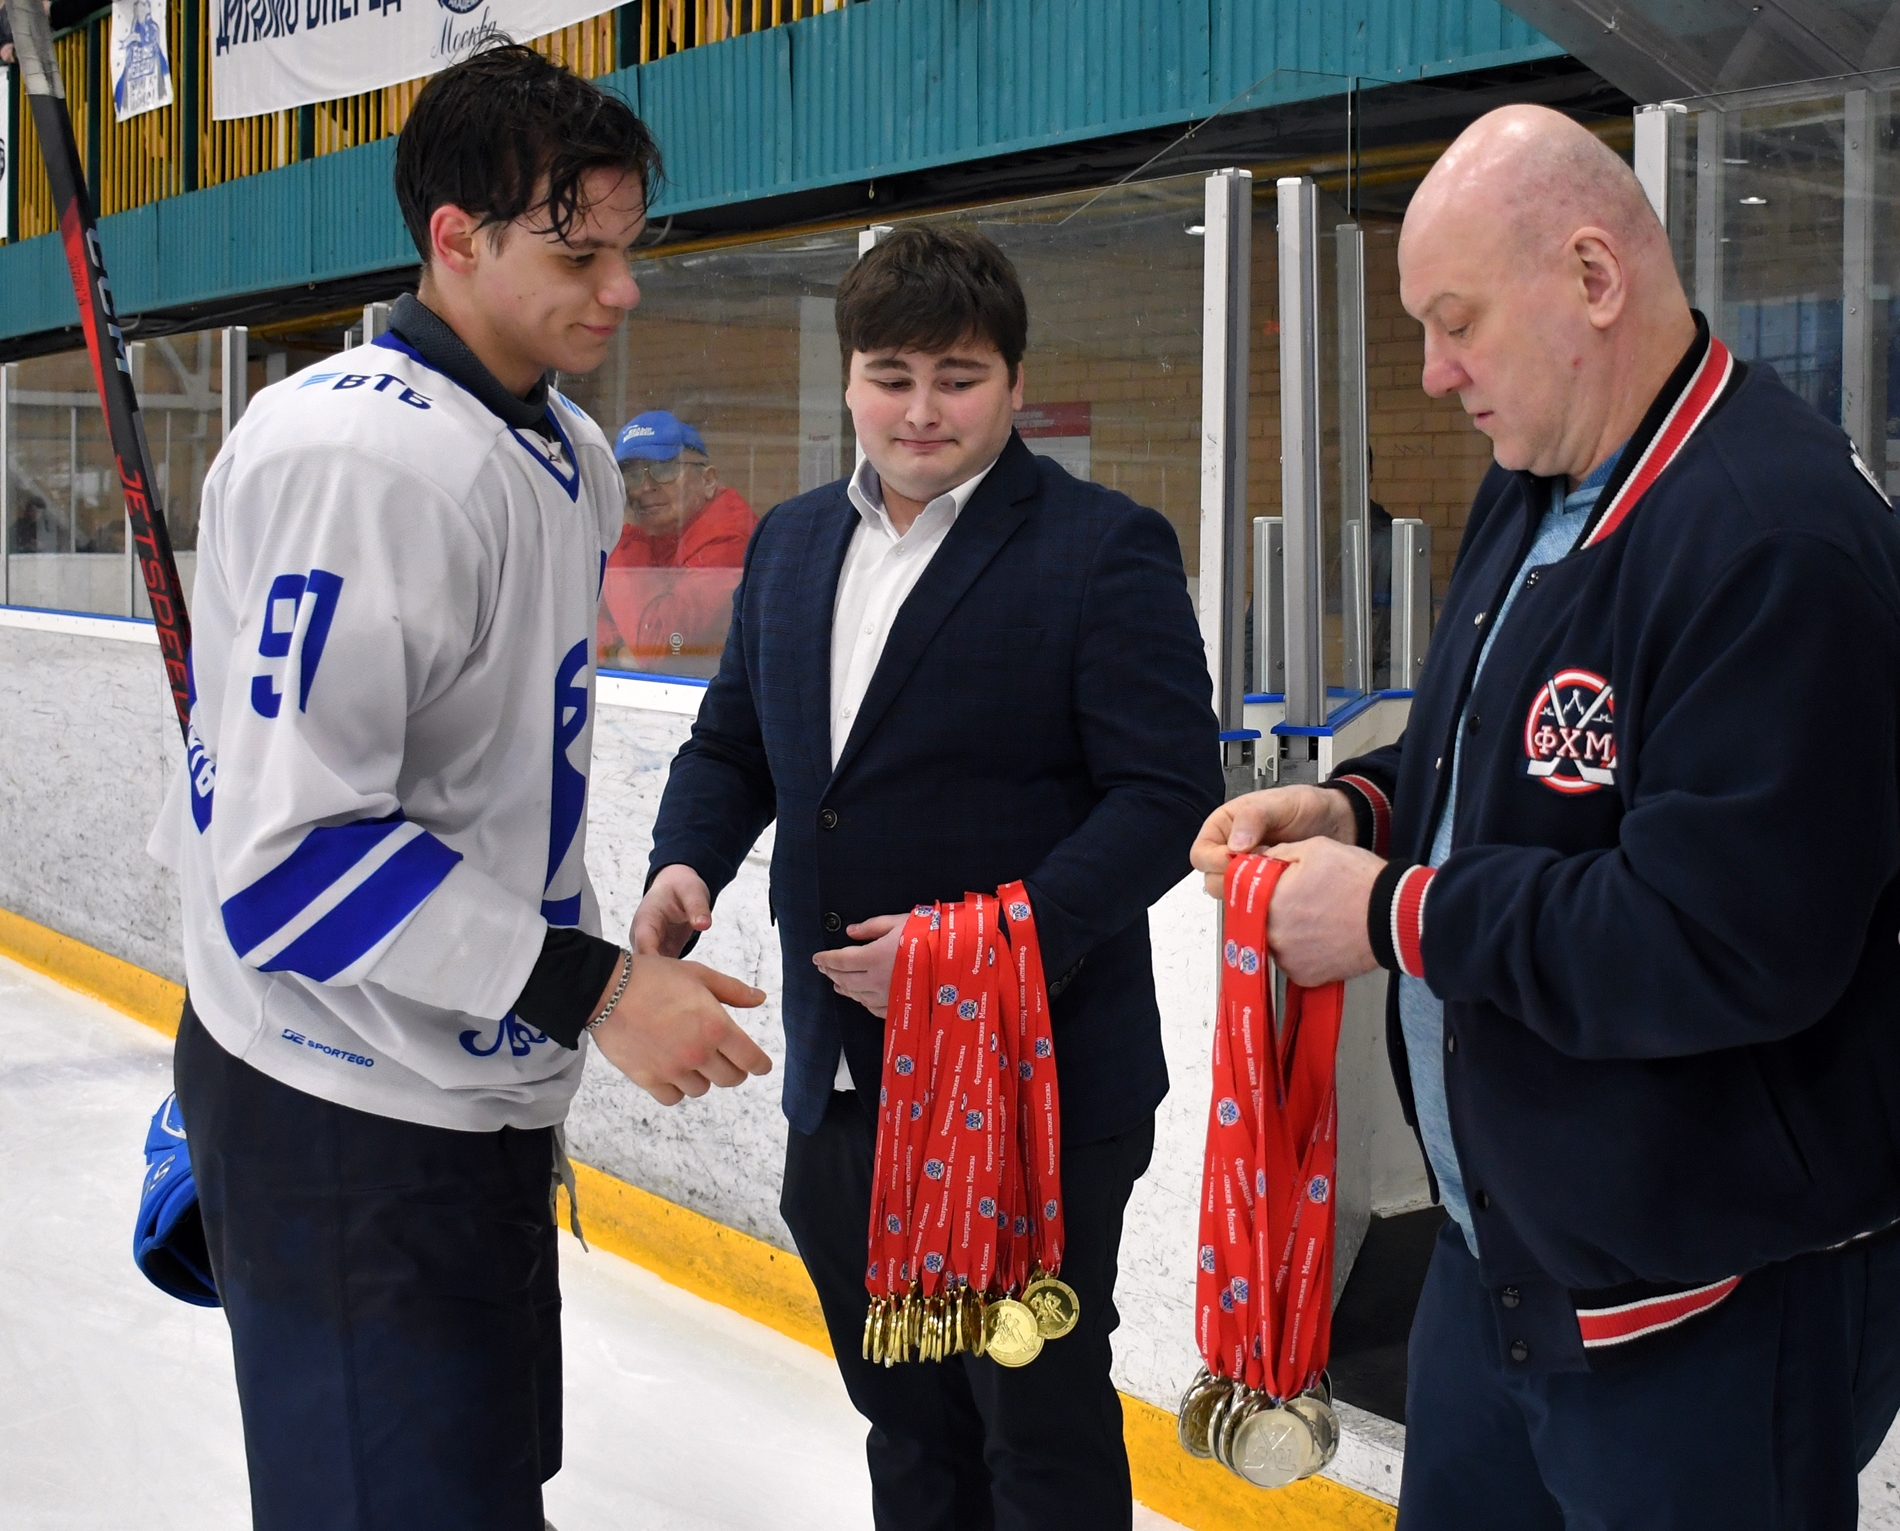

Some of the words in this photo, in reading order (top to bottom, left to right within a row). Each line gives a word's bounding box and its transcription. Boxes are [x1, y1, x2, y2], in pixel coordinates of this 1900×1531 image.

[332, 373, 434, 410] ВТБ
[1534, 724, 1613, 762] ФХМ
[907, 937, 919, 975] Федерация
[947, 932, 956, 959] Москвы
[972, 937, 983, 975] Федерация
[903, 1003, 912, 1030] Москвы
[978, 991, 988, 1019] Москвы
[1020, 1009, 1028, 1036] Москвы
[307, 1040, 375, 1068] SPORTEGO
[934, 1029, 944, 1065] Федерация
[954, 1045, 966, 1073] Москвы
[973, 1047, 984, 1085] Федерация
[951, 1075, 960, 1098] хоккея
[1044, 1082, 1052, 1110] Москвы
[894, 1099, 904, 1136] Федерация
[940, 1100, 955, 1136] Федерация
[985, 1134, 993, 1172] Федерация
[891, 1163, 899, 1190] Москвы
[936, 1190, 949, 1228] Федерация
[944, 1165, 953, 1188] хоккея
[961, 1210, 970, 1249] Федерация
[966, 1155, 976, 1183] Москвы
[918, 1203, 930, 1229] Москвы
[1226, 1208, 1236, 1244] Москвы
[980, 1243, 990, 1271] Москвы
[1301, 1237, 1316, 1274] Москвы
[1297, 1278, 1307, 1309] хоккея
[1232, 1344, 1242, 1379] Москвы
